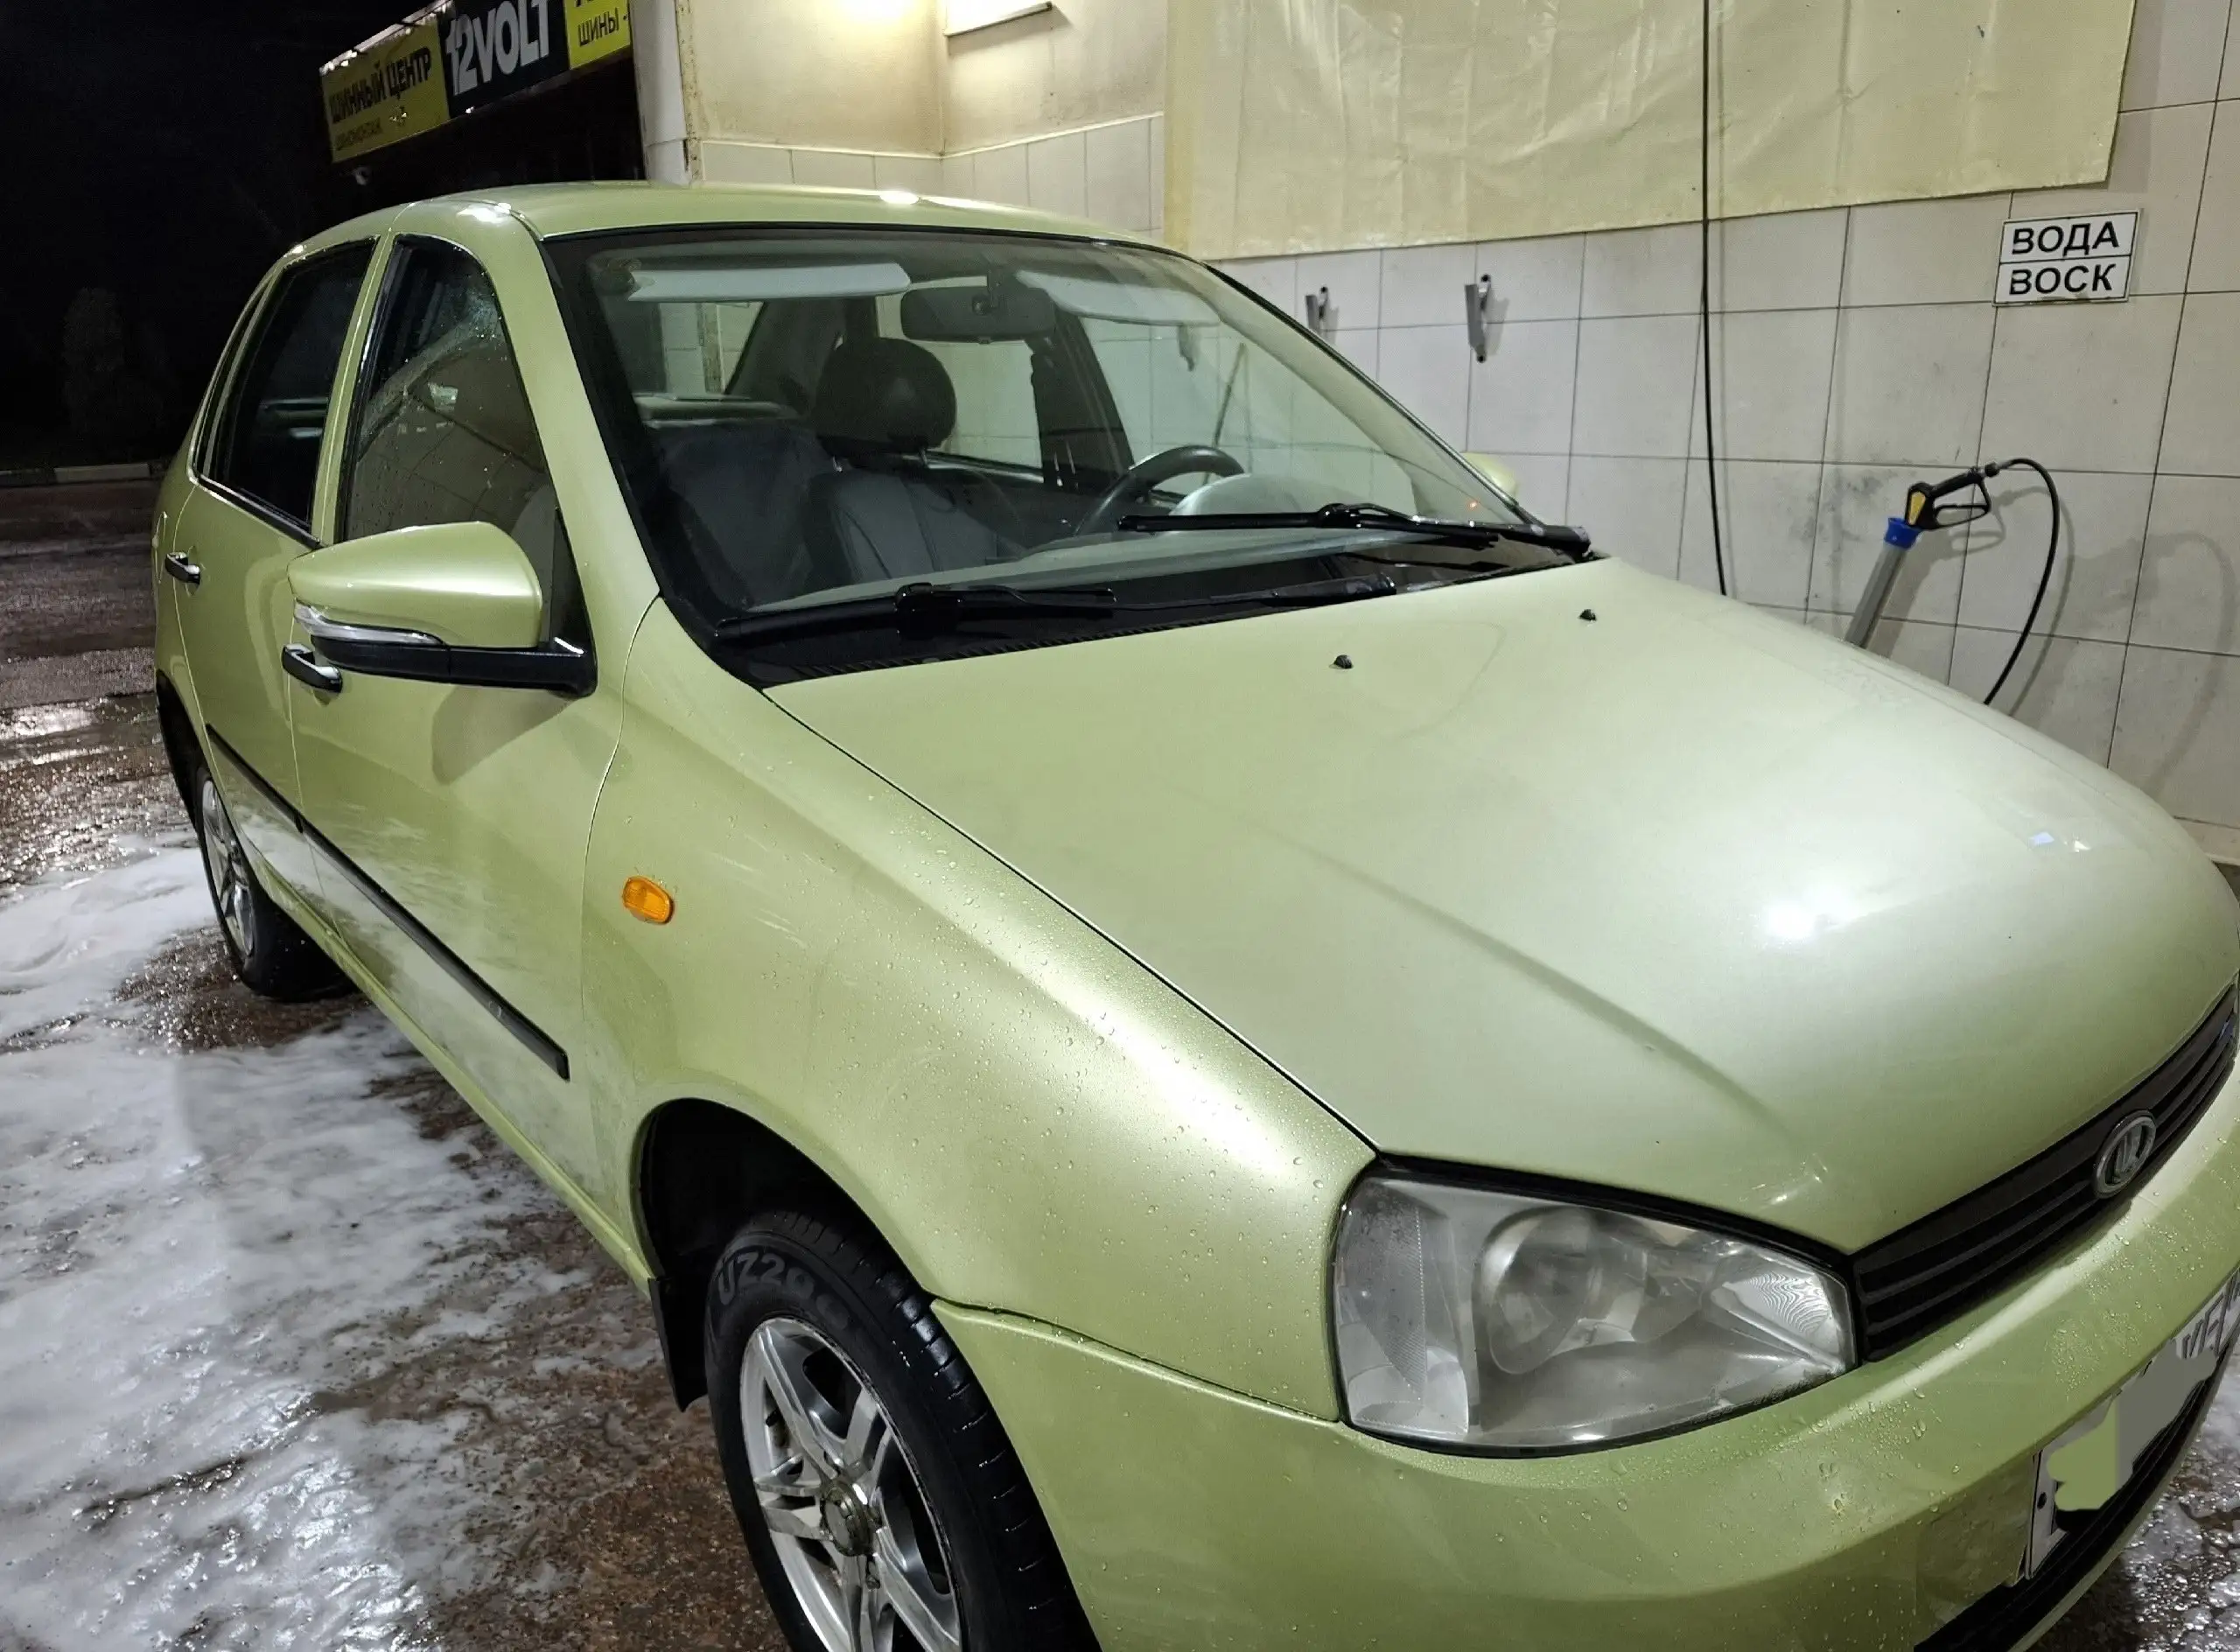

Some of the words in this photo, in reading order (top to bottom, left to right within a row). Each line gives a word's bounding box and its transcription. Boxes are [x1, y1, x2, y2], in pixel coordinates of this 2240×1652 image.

[445, 0, 550, 94] 12VOLT
[577, 9, 620, 47] ШИНЫ
[329, 61, 387, 123] ШИННЫЙ
[386, 47, 431, 100] ЦЕНТР
[2012, 220, 2120, 257] ВОДА
[2009, 263, 2117, 296] ВОСК
